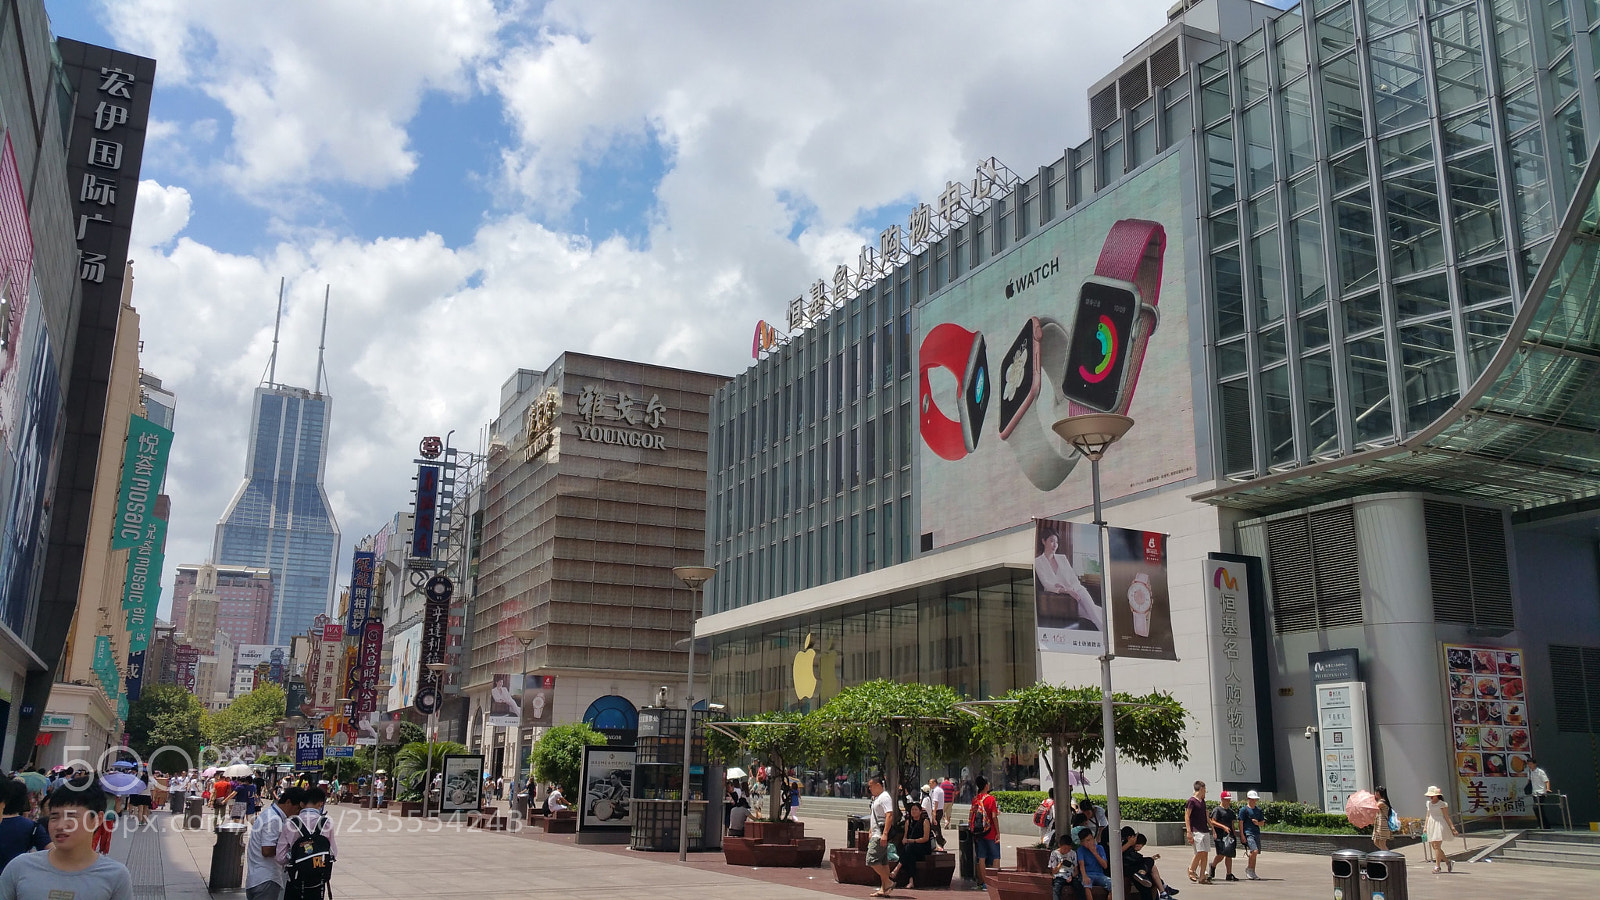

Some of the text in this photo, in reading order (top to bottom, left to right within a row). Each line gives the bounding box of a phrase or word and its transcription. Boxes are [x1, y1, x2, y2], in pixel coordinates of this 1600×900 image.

[77, 66, 135, 284] 宏伊国际广场
[786, 159, 998, 333] 恒基名人购物中心
[1015, 257, 1060, 294] WATCH
[578, 385, 667, 429] 雅戈尔
[575, 424, 667, 451] YOUNGOR
[1220, 593, 1247, 776] 恒基名人购物中心
[297, 733, 324, 749] 快照
